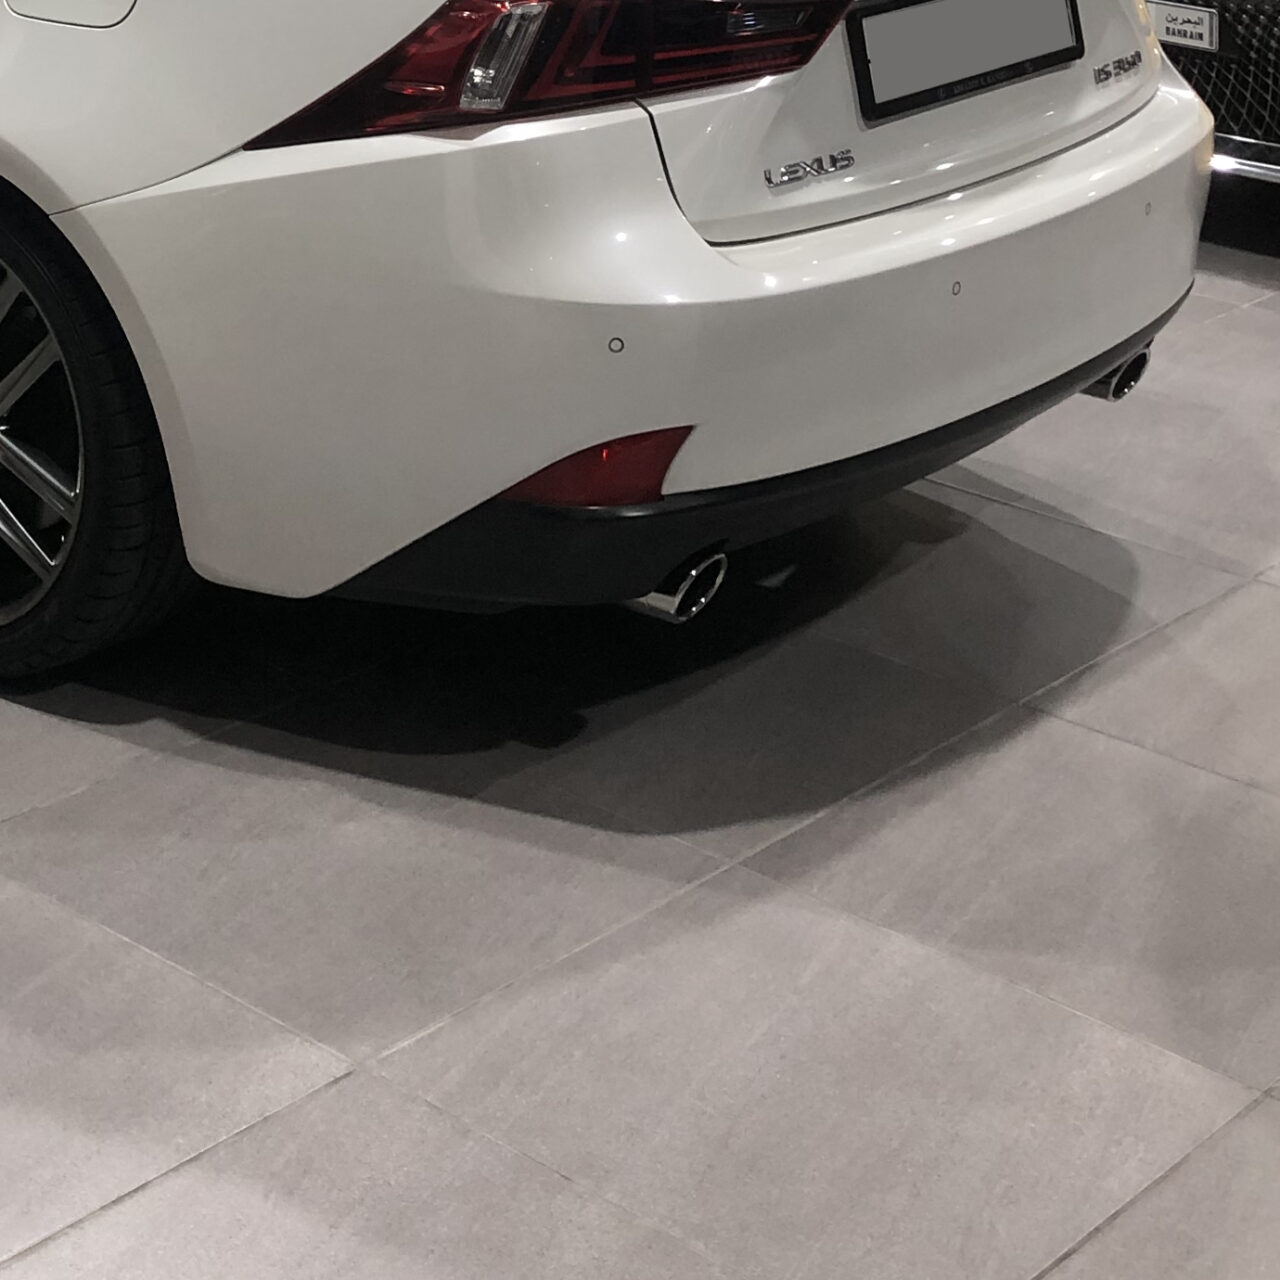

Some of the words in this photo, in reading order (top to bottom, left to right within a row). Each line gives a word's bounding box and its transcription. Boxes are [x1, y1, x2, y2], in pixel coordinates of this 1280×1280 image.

[1165, 13, 1204, 28] البحرين
[1165, 26, 1204, 41] BAHRAIN
[764, 148, 855, 188] LEXUS
